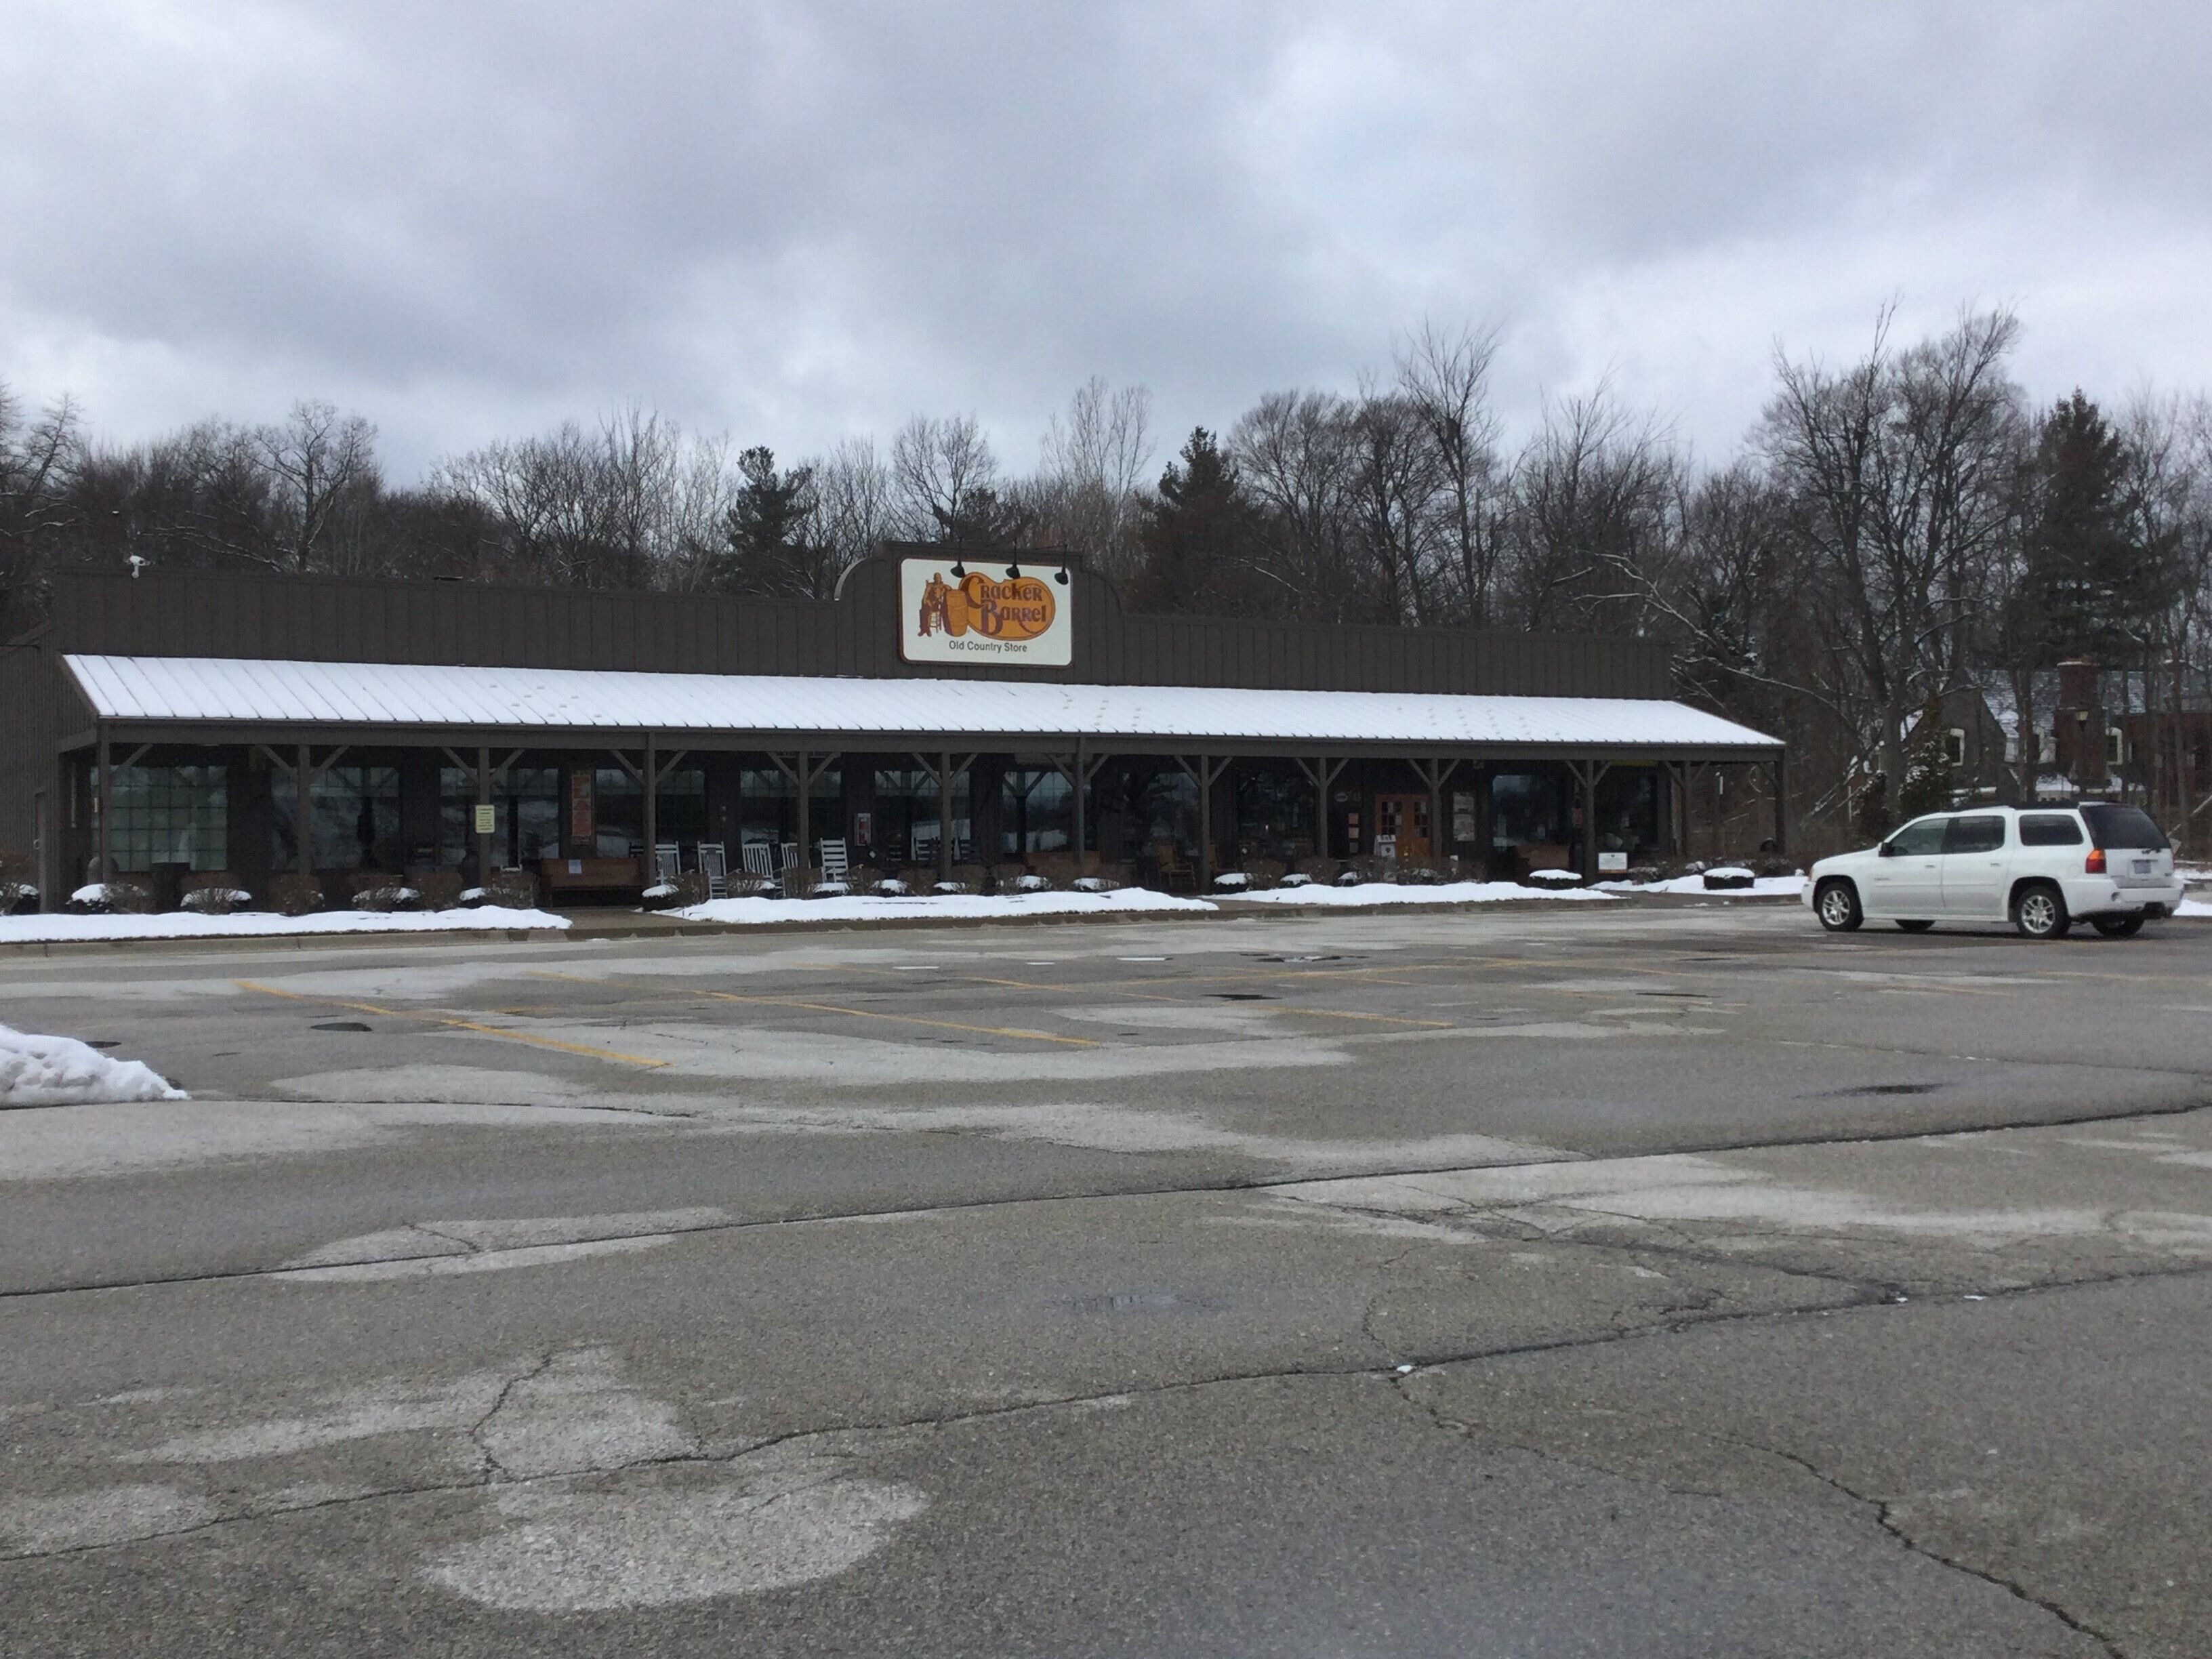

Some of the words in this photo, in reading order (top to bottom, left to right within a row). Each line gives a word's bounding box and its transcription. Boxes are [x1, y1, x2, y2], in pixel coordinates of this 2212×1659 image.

[949, 640, 964, 650] Old
[967, 641, 1002, 653] Country
[1004, 642, 1027, 652] Store
